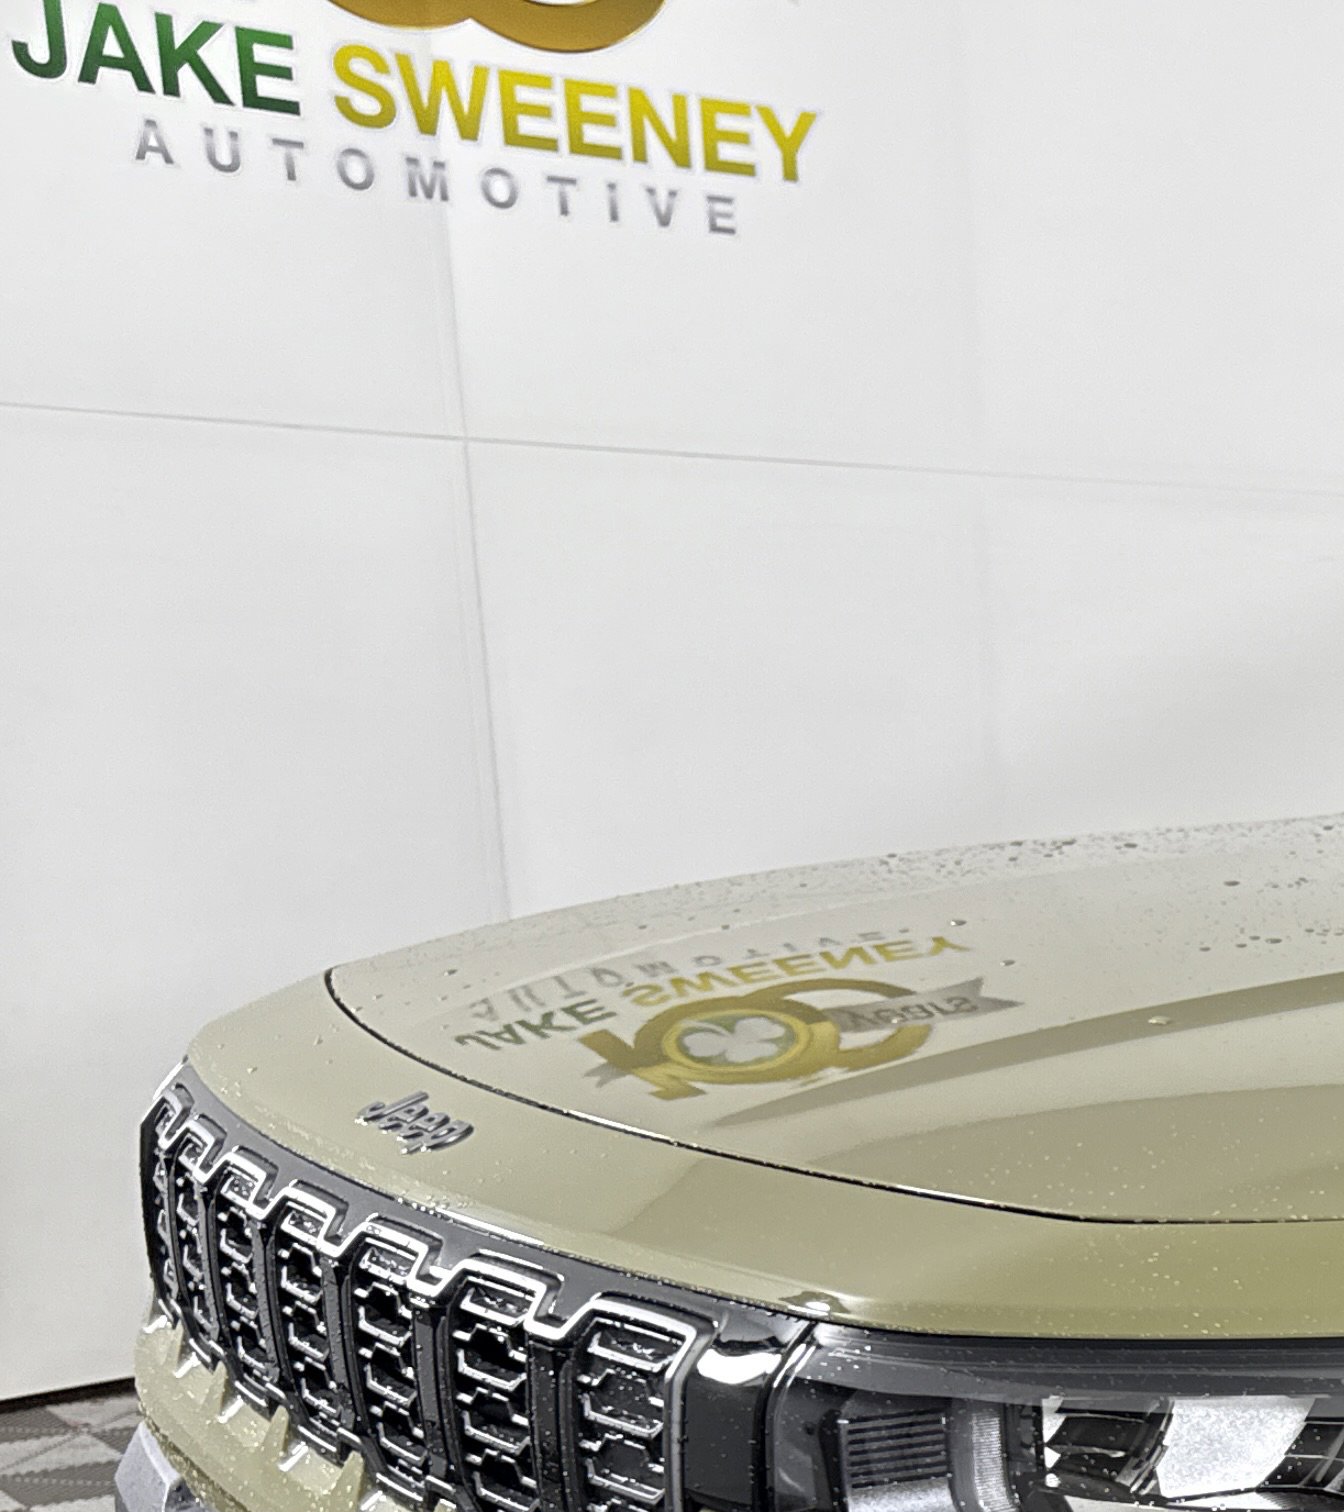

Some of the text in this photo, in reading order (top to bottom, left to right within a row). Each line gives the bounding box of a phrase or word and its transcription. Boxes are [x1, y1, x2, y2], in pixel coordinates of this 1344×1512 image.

[12, 0, 301, 116] JAKE
[332, 44, 818, 183] SWEENEY
[135, 119, 738, 236] AUTOMOTIVE
[355, 1091, 475, 1154] Jeep
